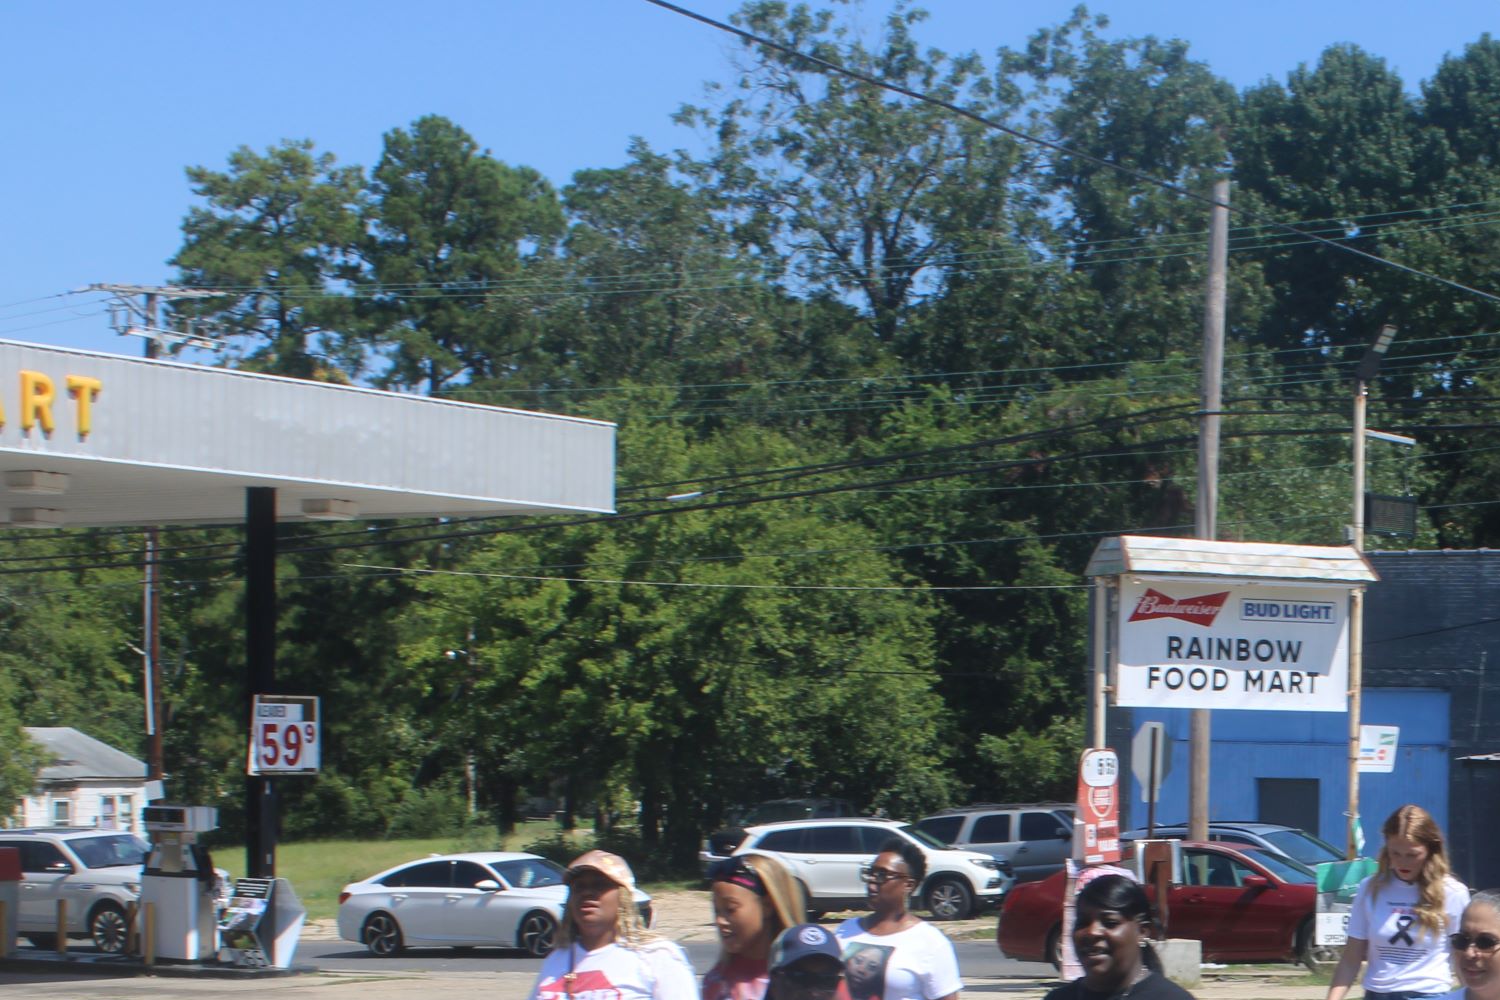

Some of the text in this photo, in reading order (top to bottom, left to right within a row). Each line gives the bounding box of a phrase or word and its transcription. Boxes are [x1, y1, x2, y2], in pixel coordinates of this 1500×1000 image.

[0, 368, 102, 443] RT
[1137, 596, 1222, 616] Budweiser
[1244, 602, 1332, 620] BUD LIGHT
[1167, 635, 1303, 662] RAINBOW
[1147, 667, 1320, 694] FOOD MART
